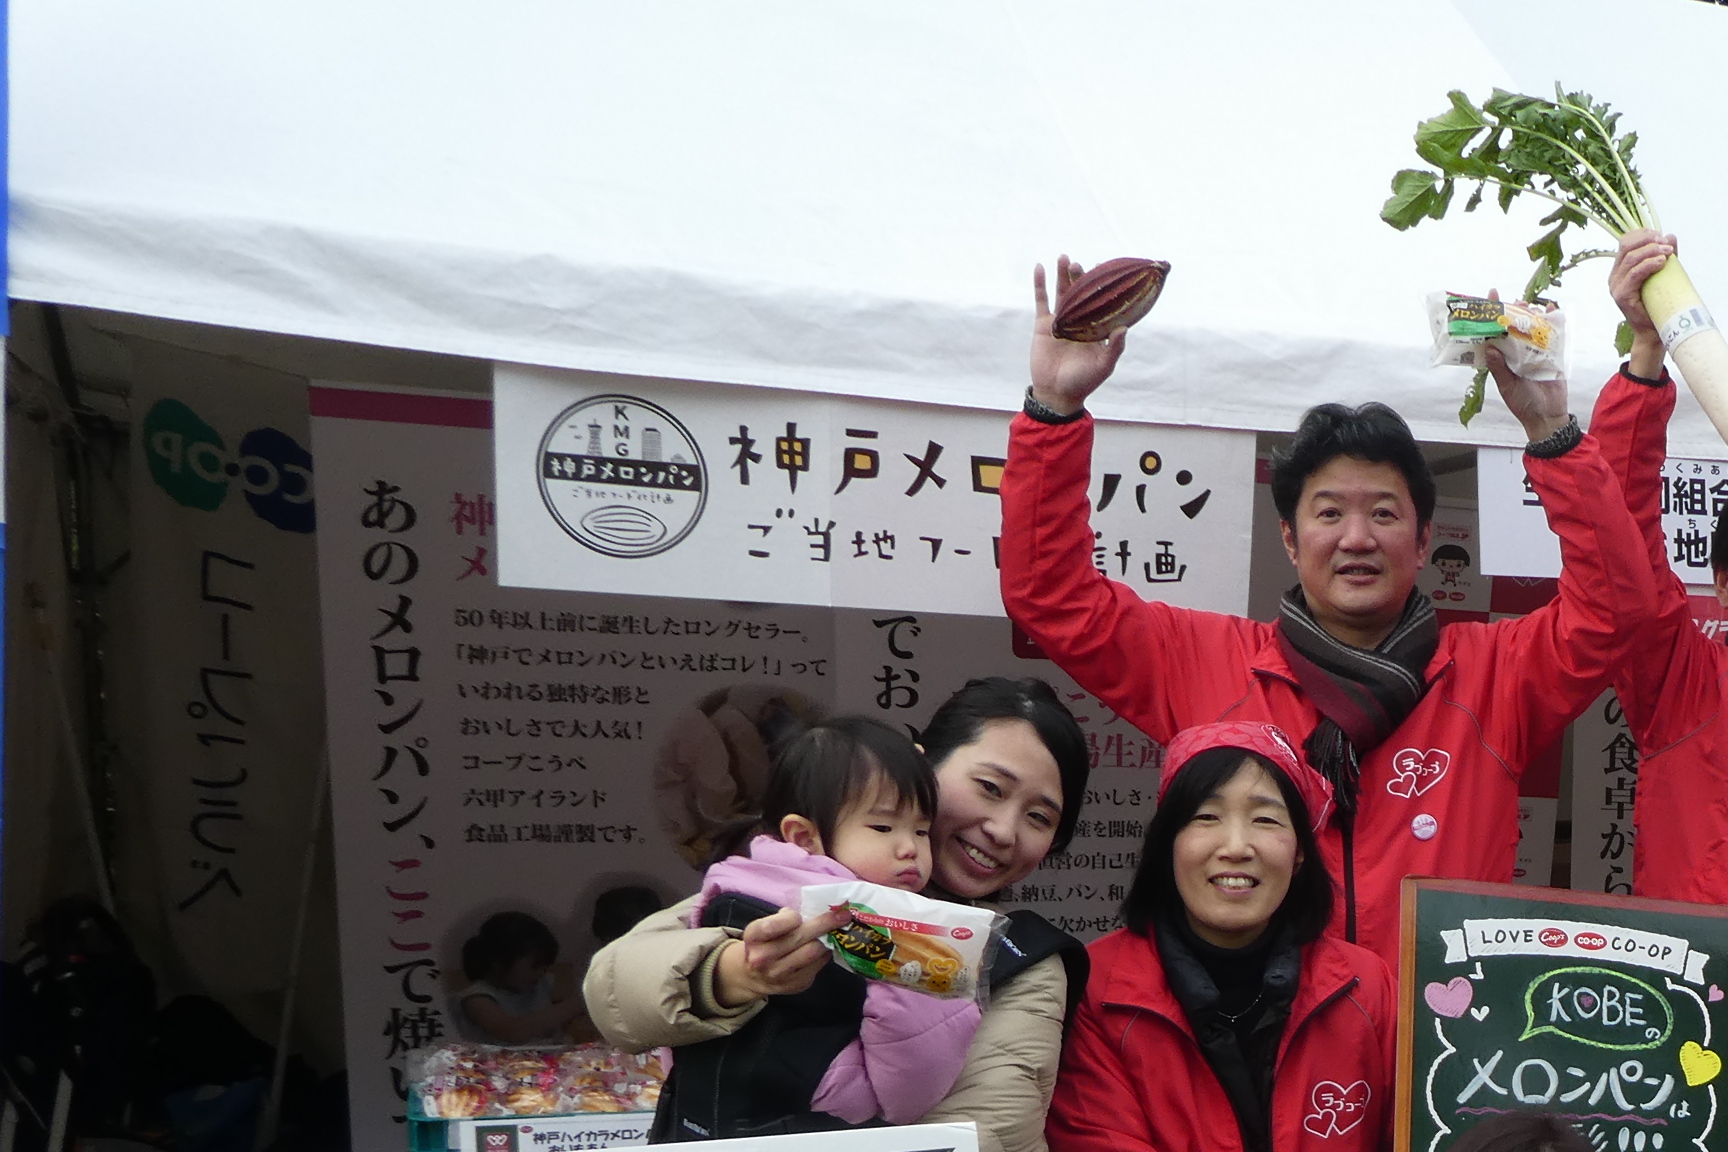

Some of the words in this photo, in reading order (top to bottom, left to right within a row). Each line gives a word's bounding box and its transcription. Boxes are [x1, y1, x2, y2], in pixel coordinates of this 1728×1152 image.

[550, 456, 695, 487] 神戸メロンパン
[462, 752, 587, 772] コープこうべ
[462, 787, 607, 809] 六甲アイランド
[1481, 929, 1534, 945] LOVE
[1611, 936, 1673, 961] CO-OP
